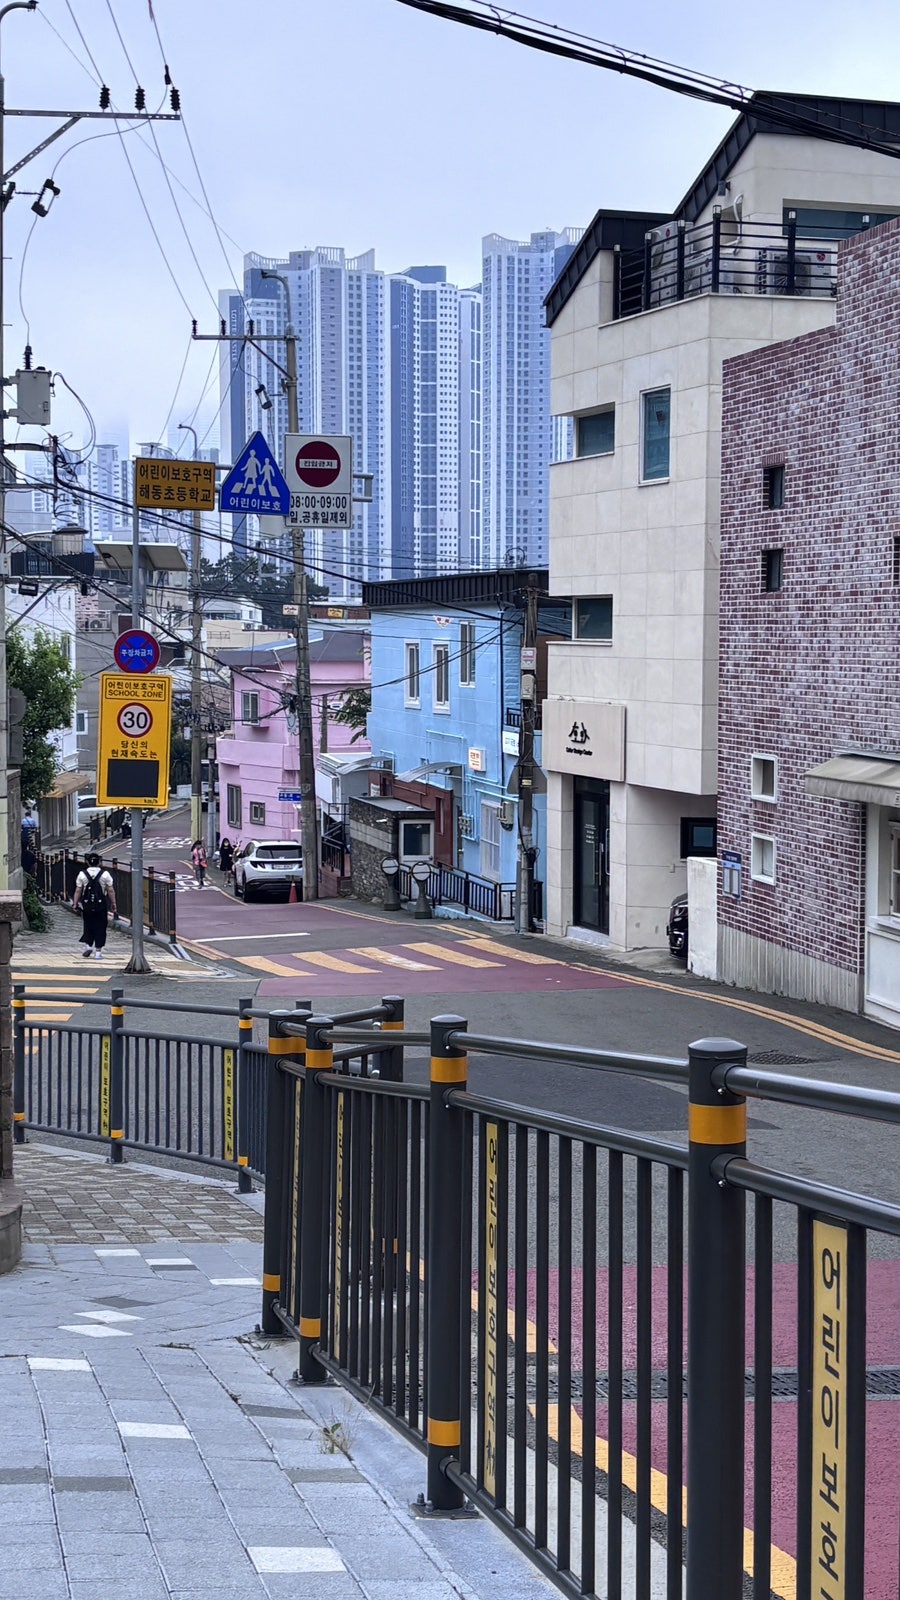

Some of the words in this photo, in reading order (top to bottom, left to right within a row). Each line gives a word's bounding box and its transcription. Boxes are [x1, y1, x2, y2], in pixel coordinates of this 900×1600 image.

[139, 464, 212, 483] 어린이보호구역
[139, 484, 212, 503] 해동초등학교
[229, 496, 281, 511] 어린이보호
[107, 681, 164, 691] 어린이보호구역
[107, 689, 140, 697] SCHOOL
[142, 690, 164, 698] ZONE
[123, 711, 148, 729] 30
[120, 740, 148, 749] 당신의
[111, 749, 158, 759] 현재속도는
[818, 1247, 841, 1600] 어린이보호
